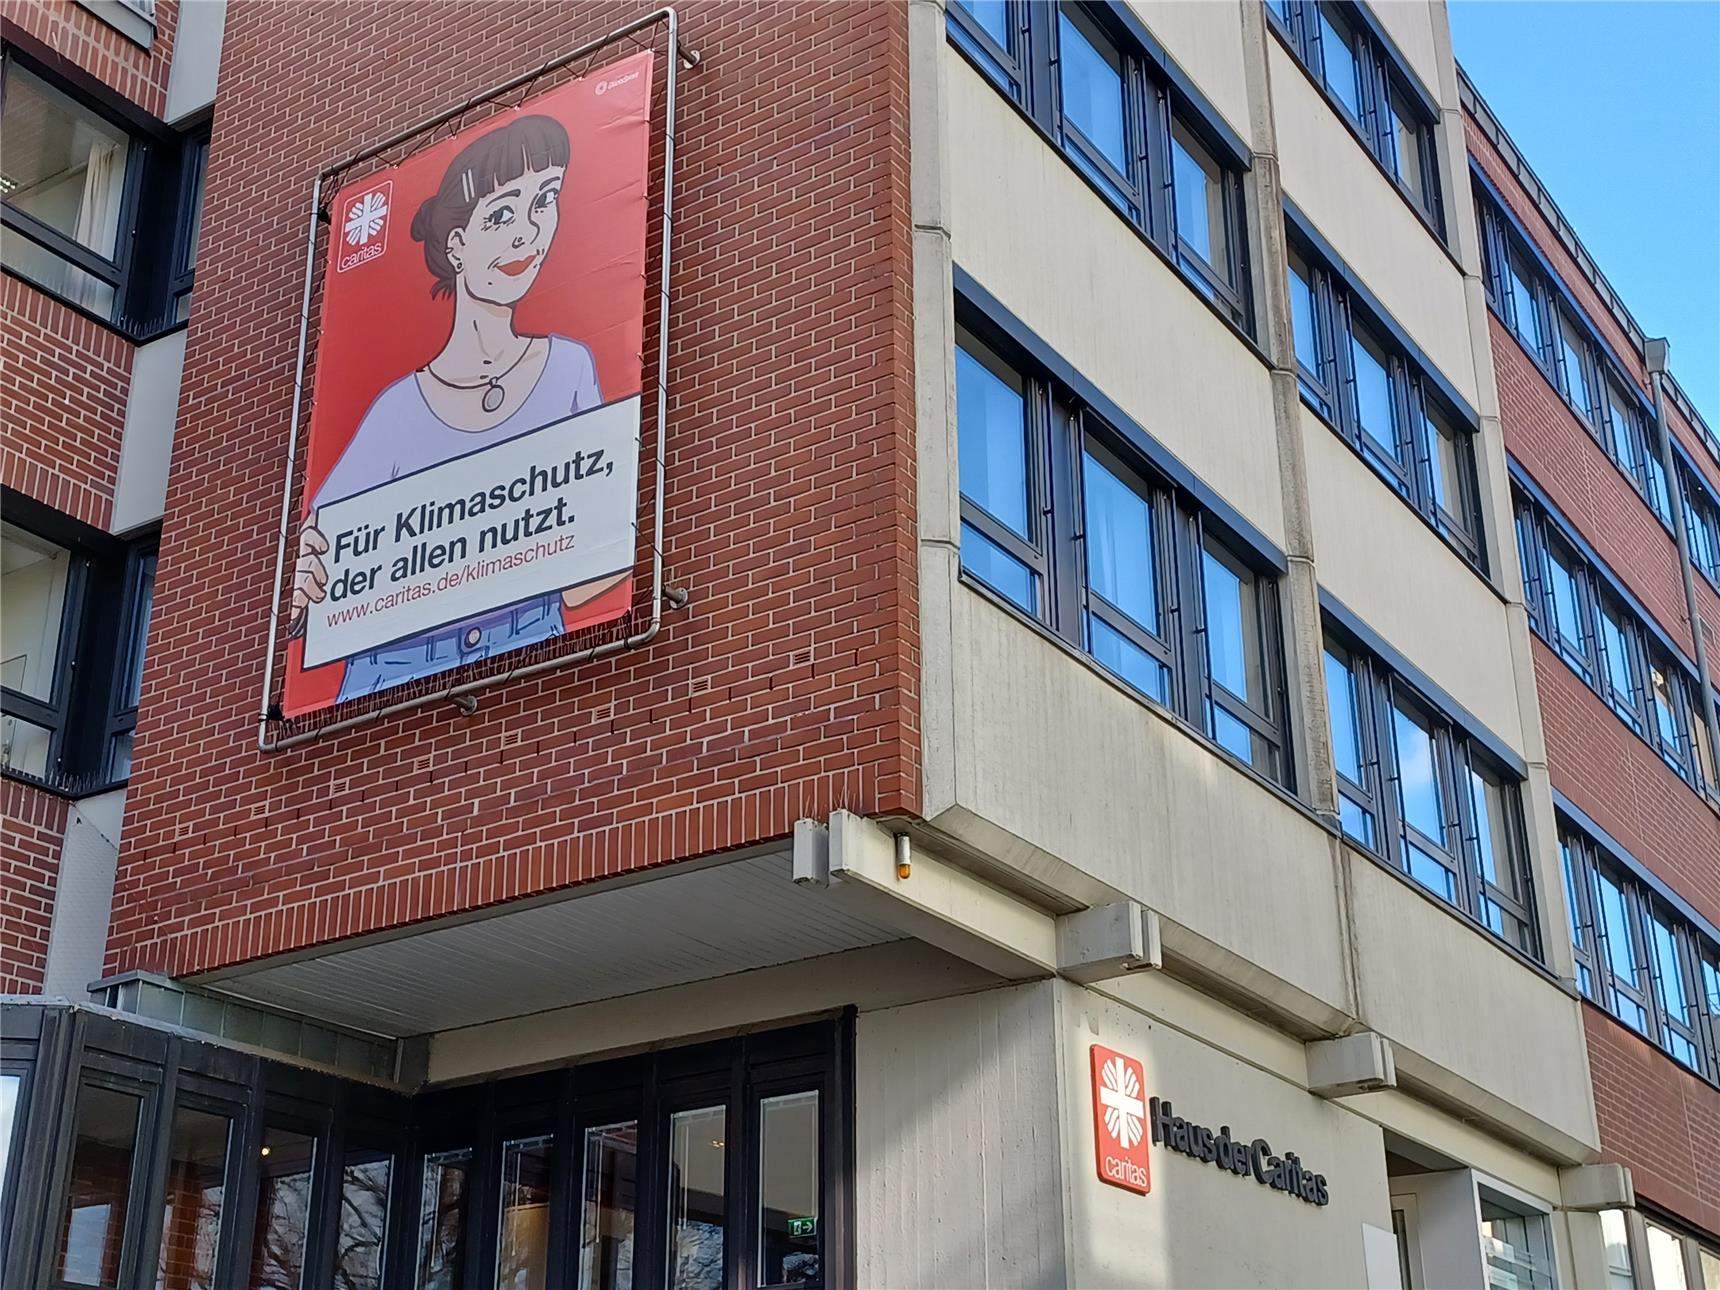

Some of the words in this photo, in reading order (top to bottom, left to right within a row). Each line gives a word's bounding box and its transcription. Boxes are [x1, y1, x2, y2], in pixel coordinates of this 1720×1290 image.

[341, 243, 382, 268] caritas
[330, 564, 382, 601] der
[390, 536, 467, 582] allen
[478, 497, 575, 553] nutzt.
[333, 524, 386, 563] Für
[394, 446, 614, 543] Klimaschutz,
[326, 534, 575, 627] www.caritas.de/klimaschutz
[1105, 1156, 1148, 1188] caritas
[1149, 1096, 1217, 1163] Haus
[1214, 1125, 1252, 1177] der
[1251, 1138, 1330, 1206] Caritas
